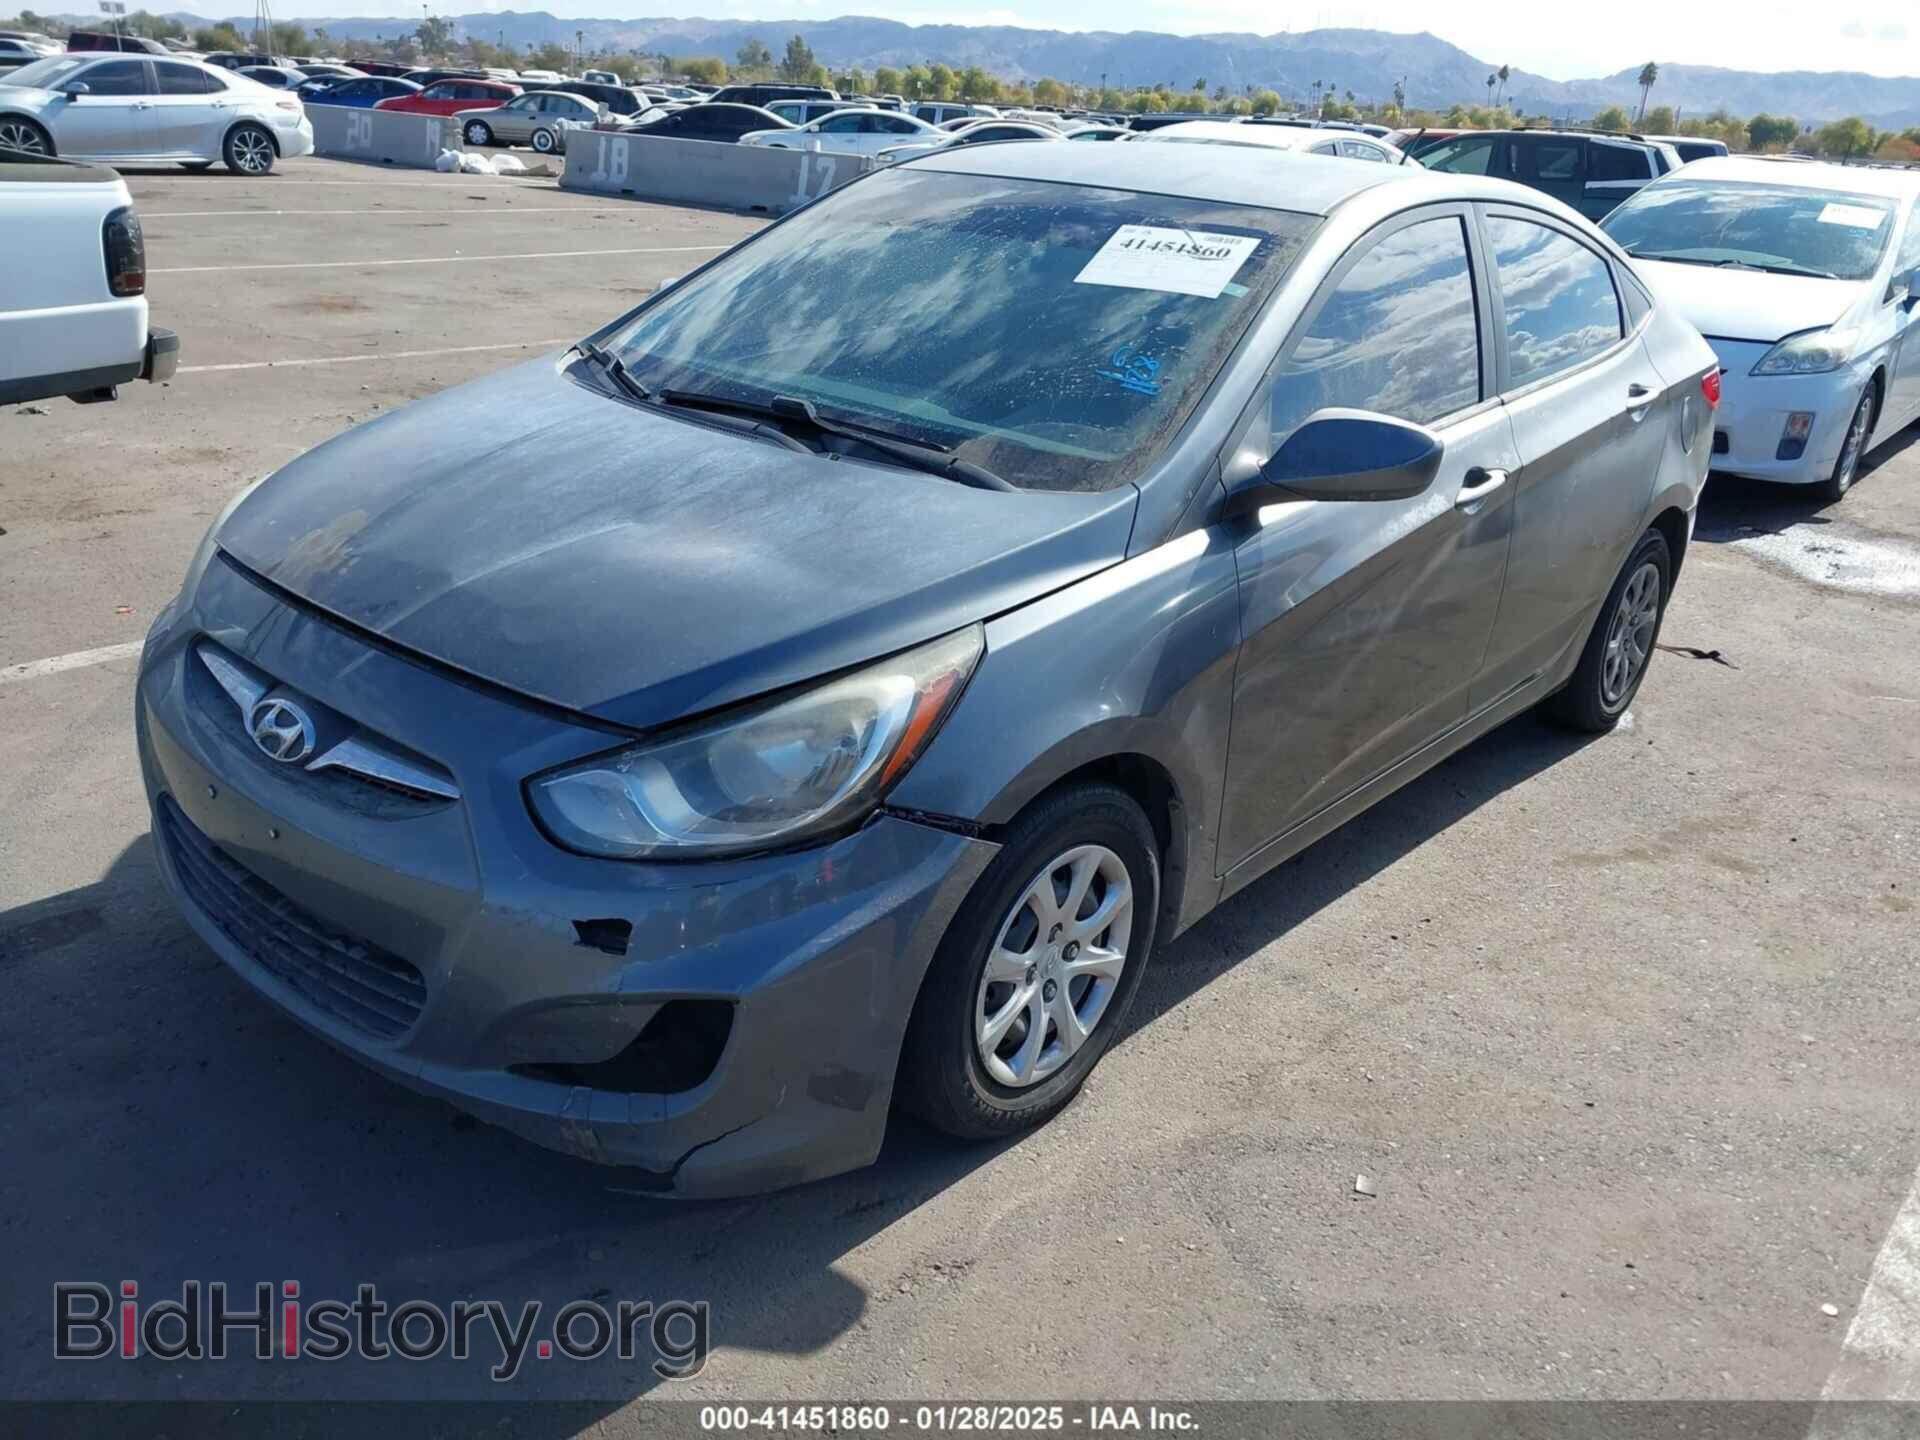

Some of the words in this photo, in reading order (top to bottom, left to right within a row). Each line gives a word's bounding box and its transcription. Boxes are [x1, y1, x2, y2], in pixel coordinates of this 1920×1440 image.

[345, 111, 373, 150] 20
[590, 135, 630, 183] 18
[791, 153, 837, 204] 17
[1119, 238, 1233, 257] 41451860
